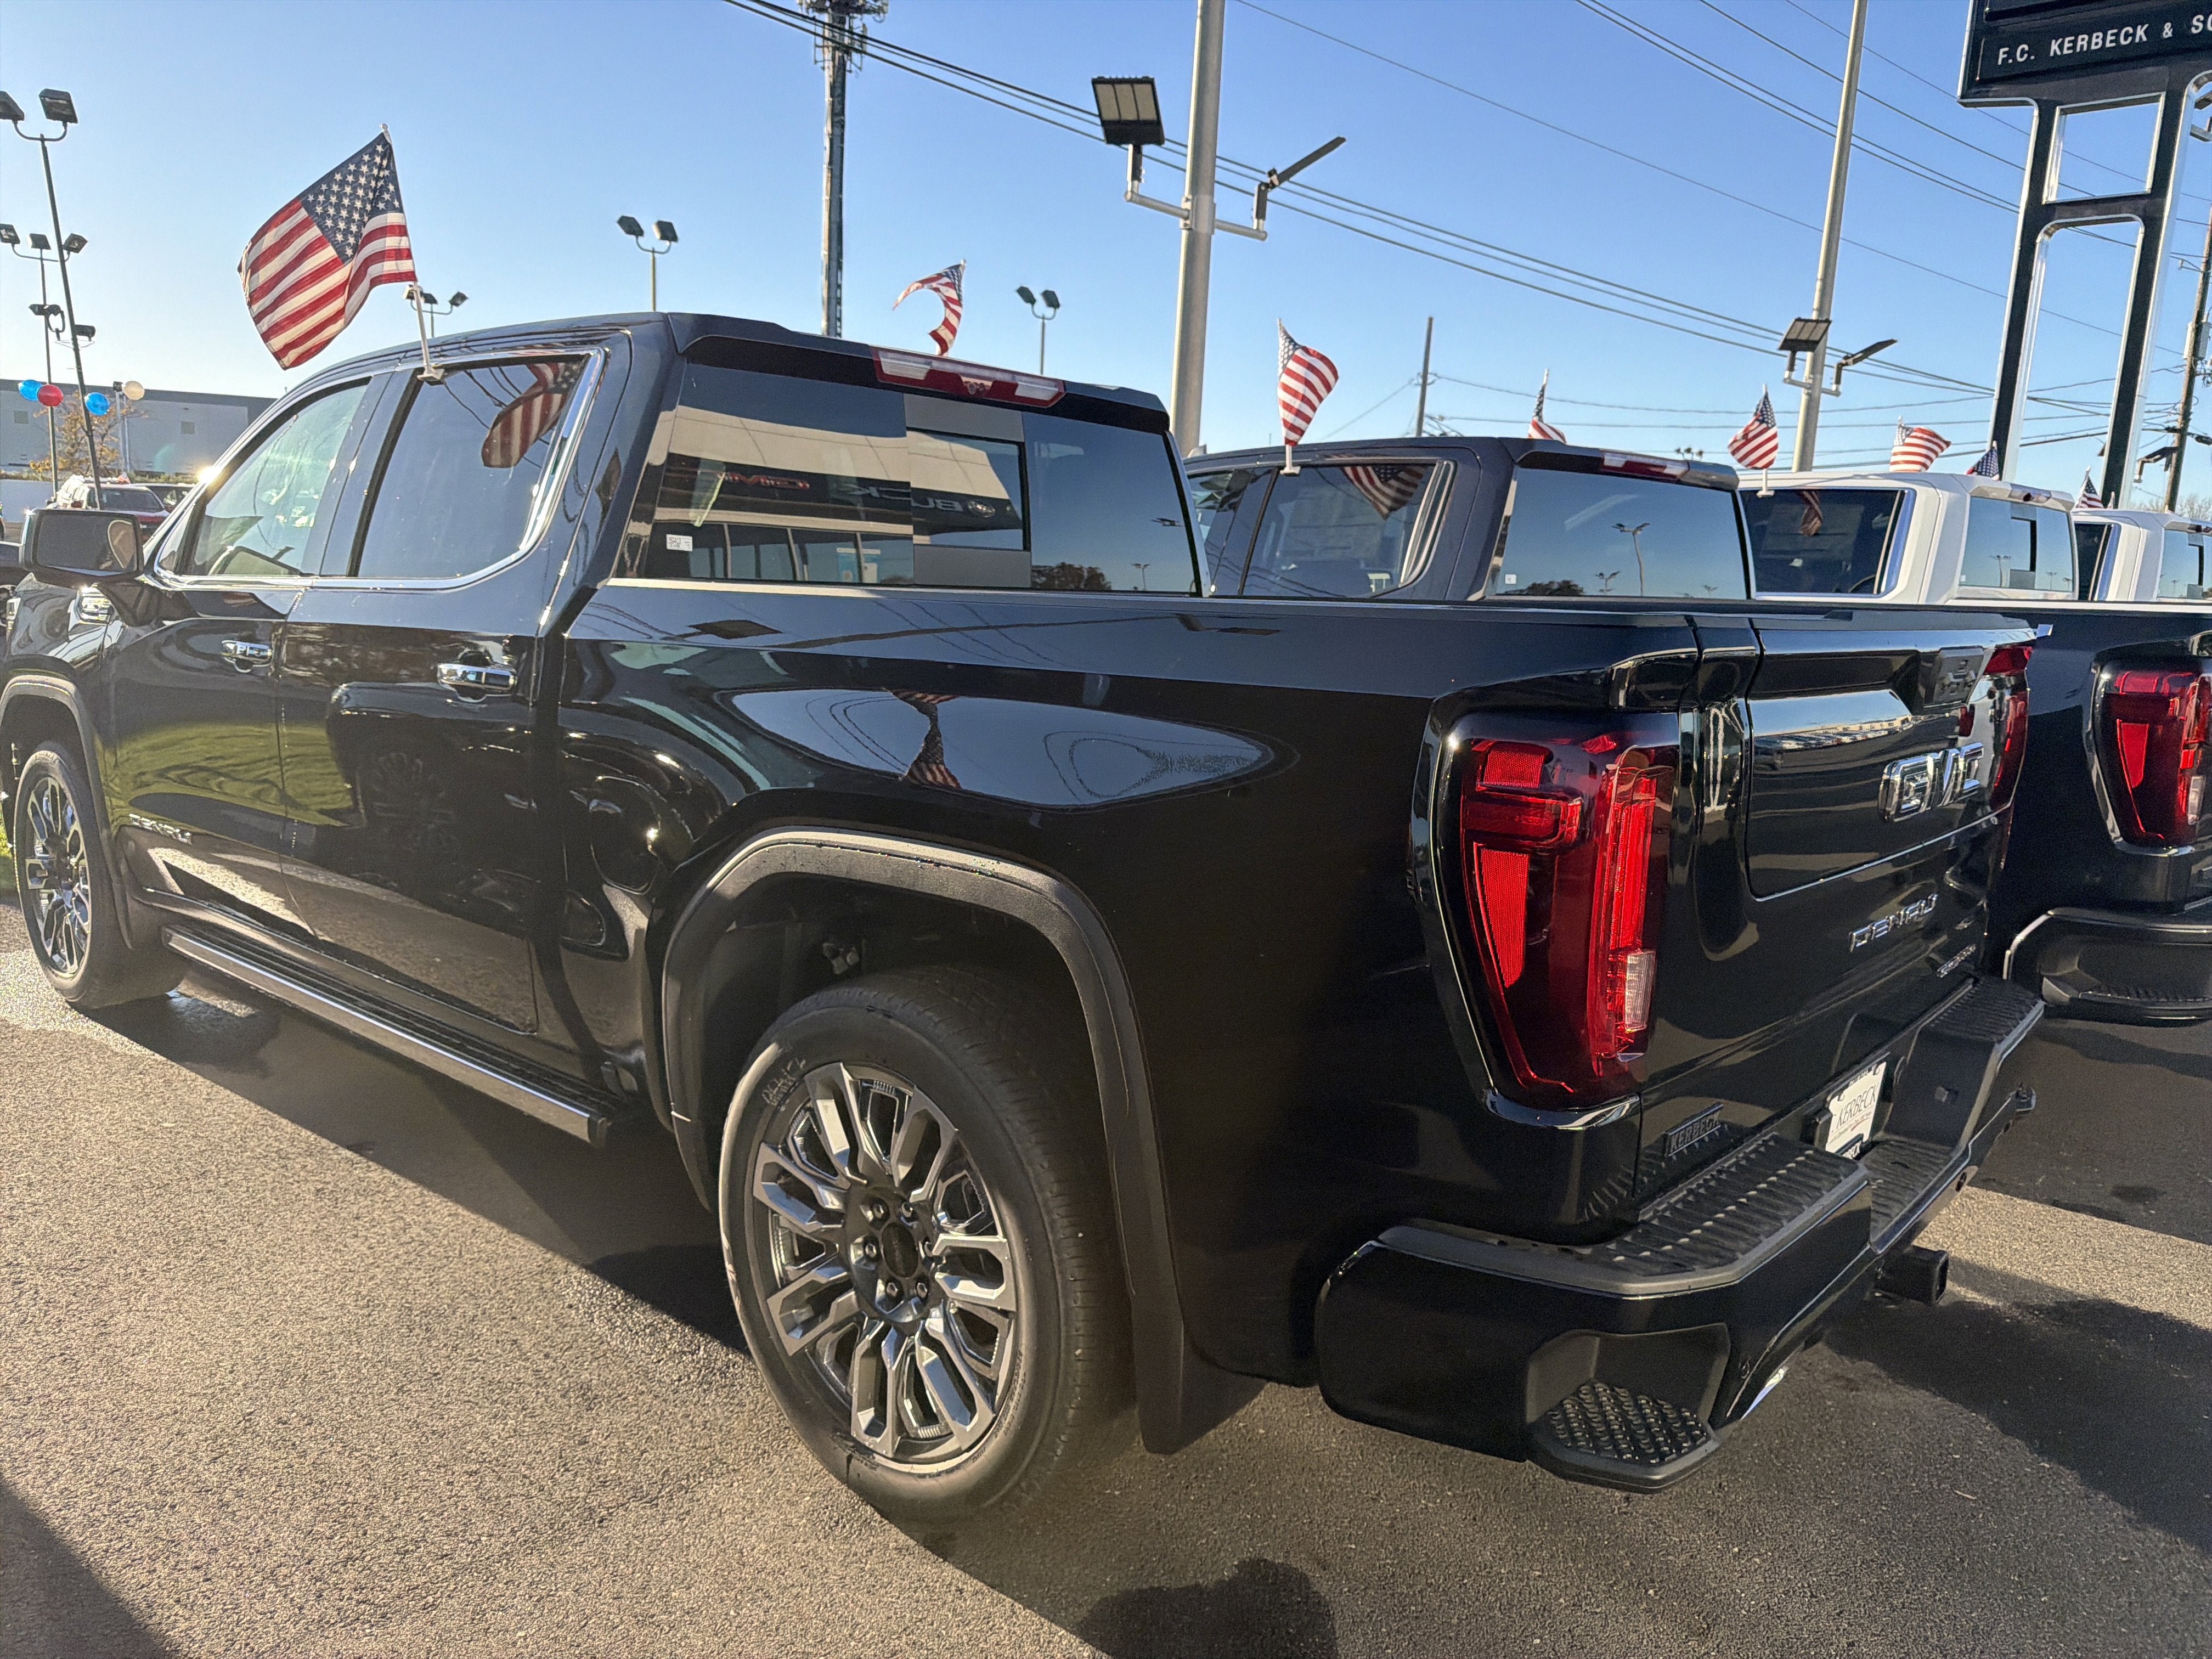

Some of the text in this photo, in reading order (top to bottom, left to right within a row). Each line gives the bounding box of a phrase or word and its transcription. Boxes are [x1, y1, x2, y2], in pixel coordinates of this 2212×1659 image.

[1997, 44, 2036, 65] F.C.
[2050, 24, 2149, 57] KERBECK
[2162, 22, 2174, 38] &
[1878, 742, 1984, 822] GMC
[1836, 1082, 1880, 1129] KERBECK
[1669, 1111, 1720, 1153] KERBECK
